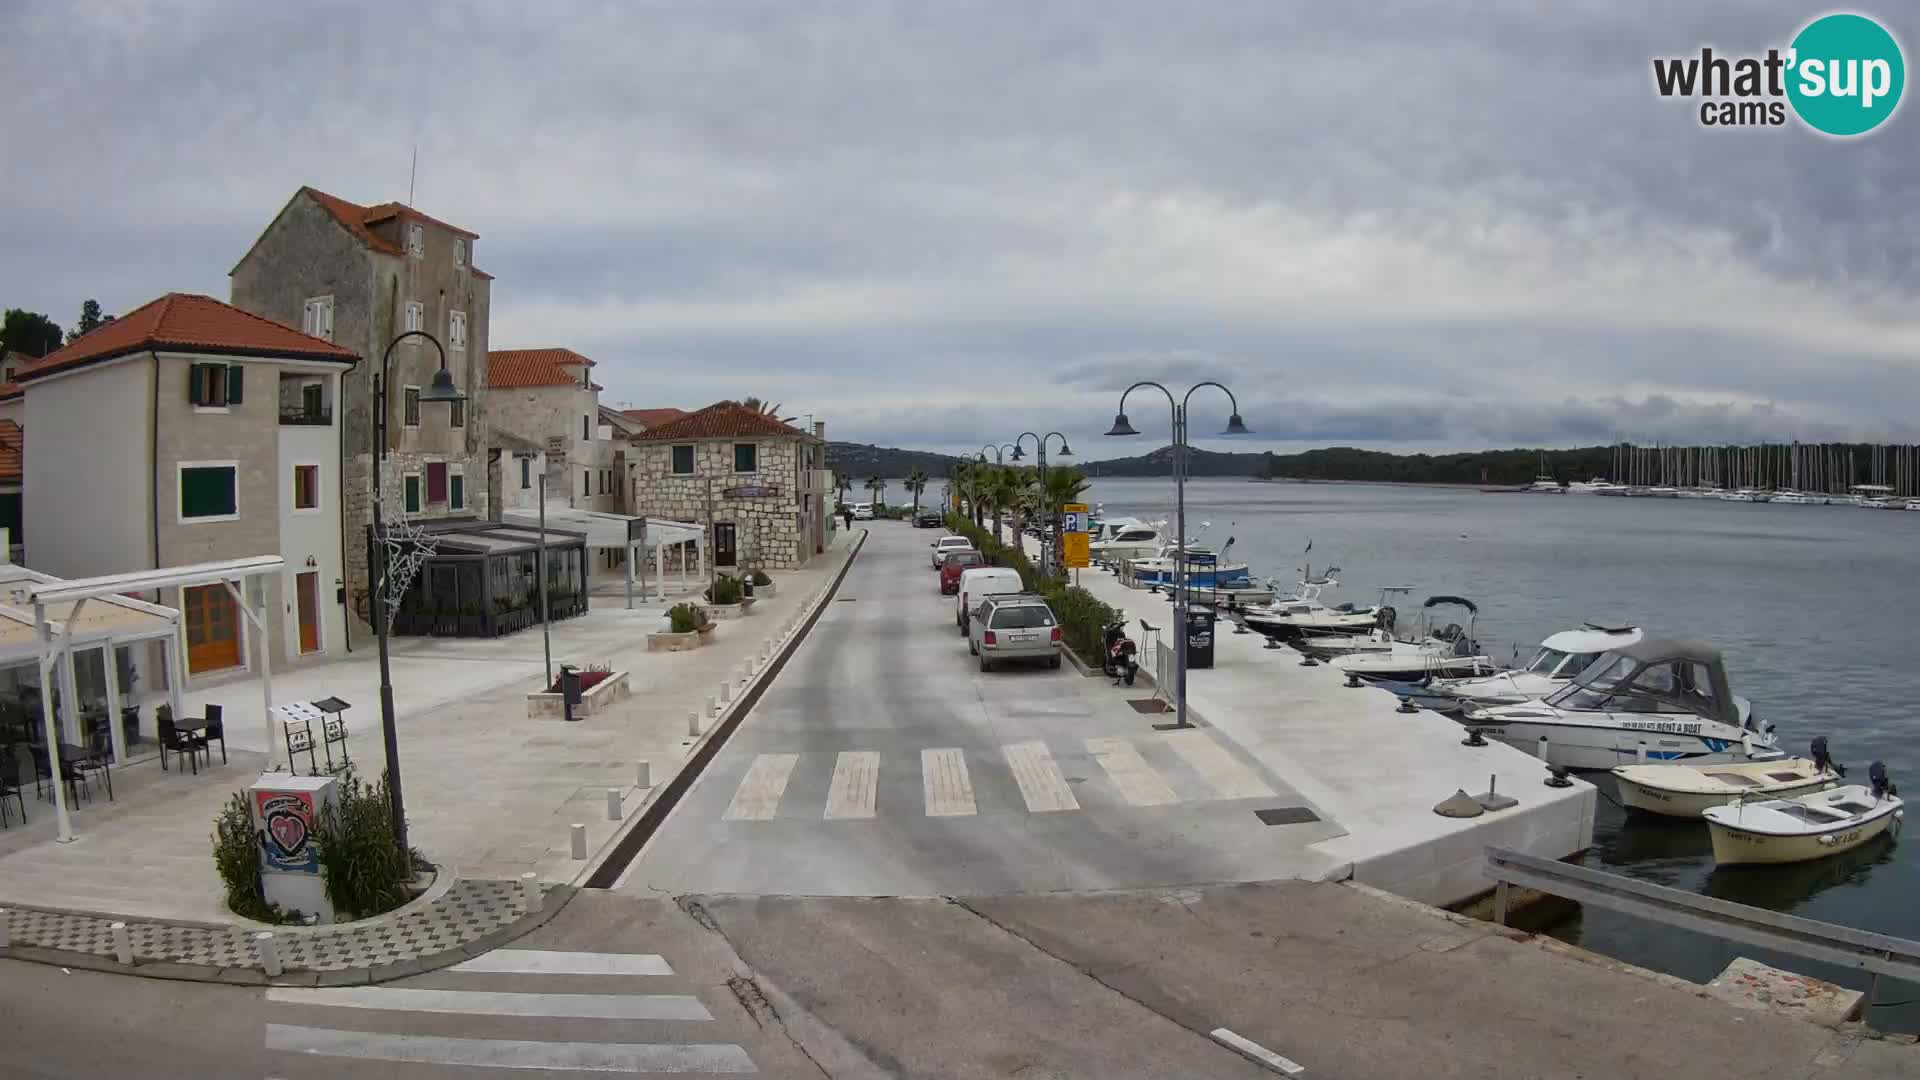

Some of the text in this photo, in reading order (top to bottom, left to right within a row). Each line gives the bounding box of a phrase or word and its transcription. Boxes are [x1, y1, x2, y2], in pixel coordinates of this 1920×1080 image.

[1066, 514, 1076, 530] P
[1657, 722, 1676, 733] RENT
[1684, 723, 1702, 734] BOAT
